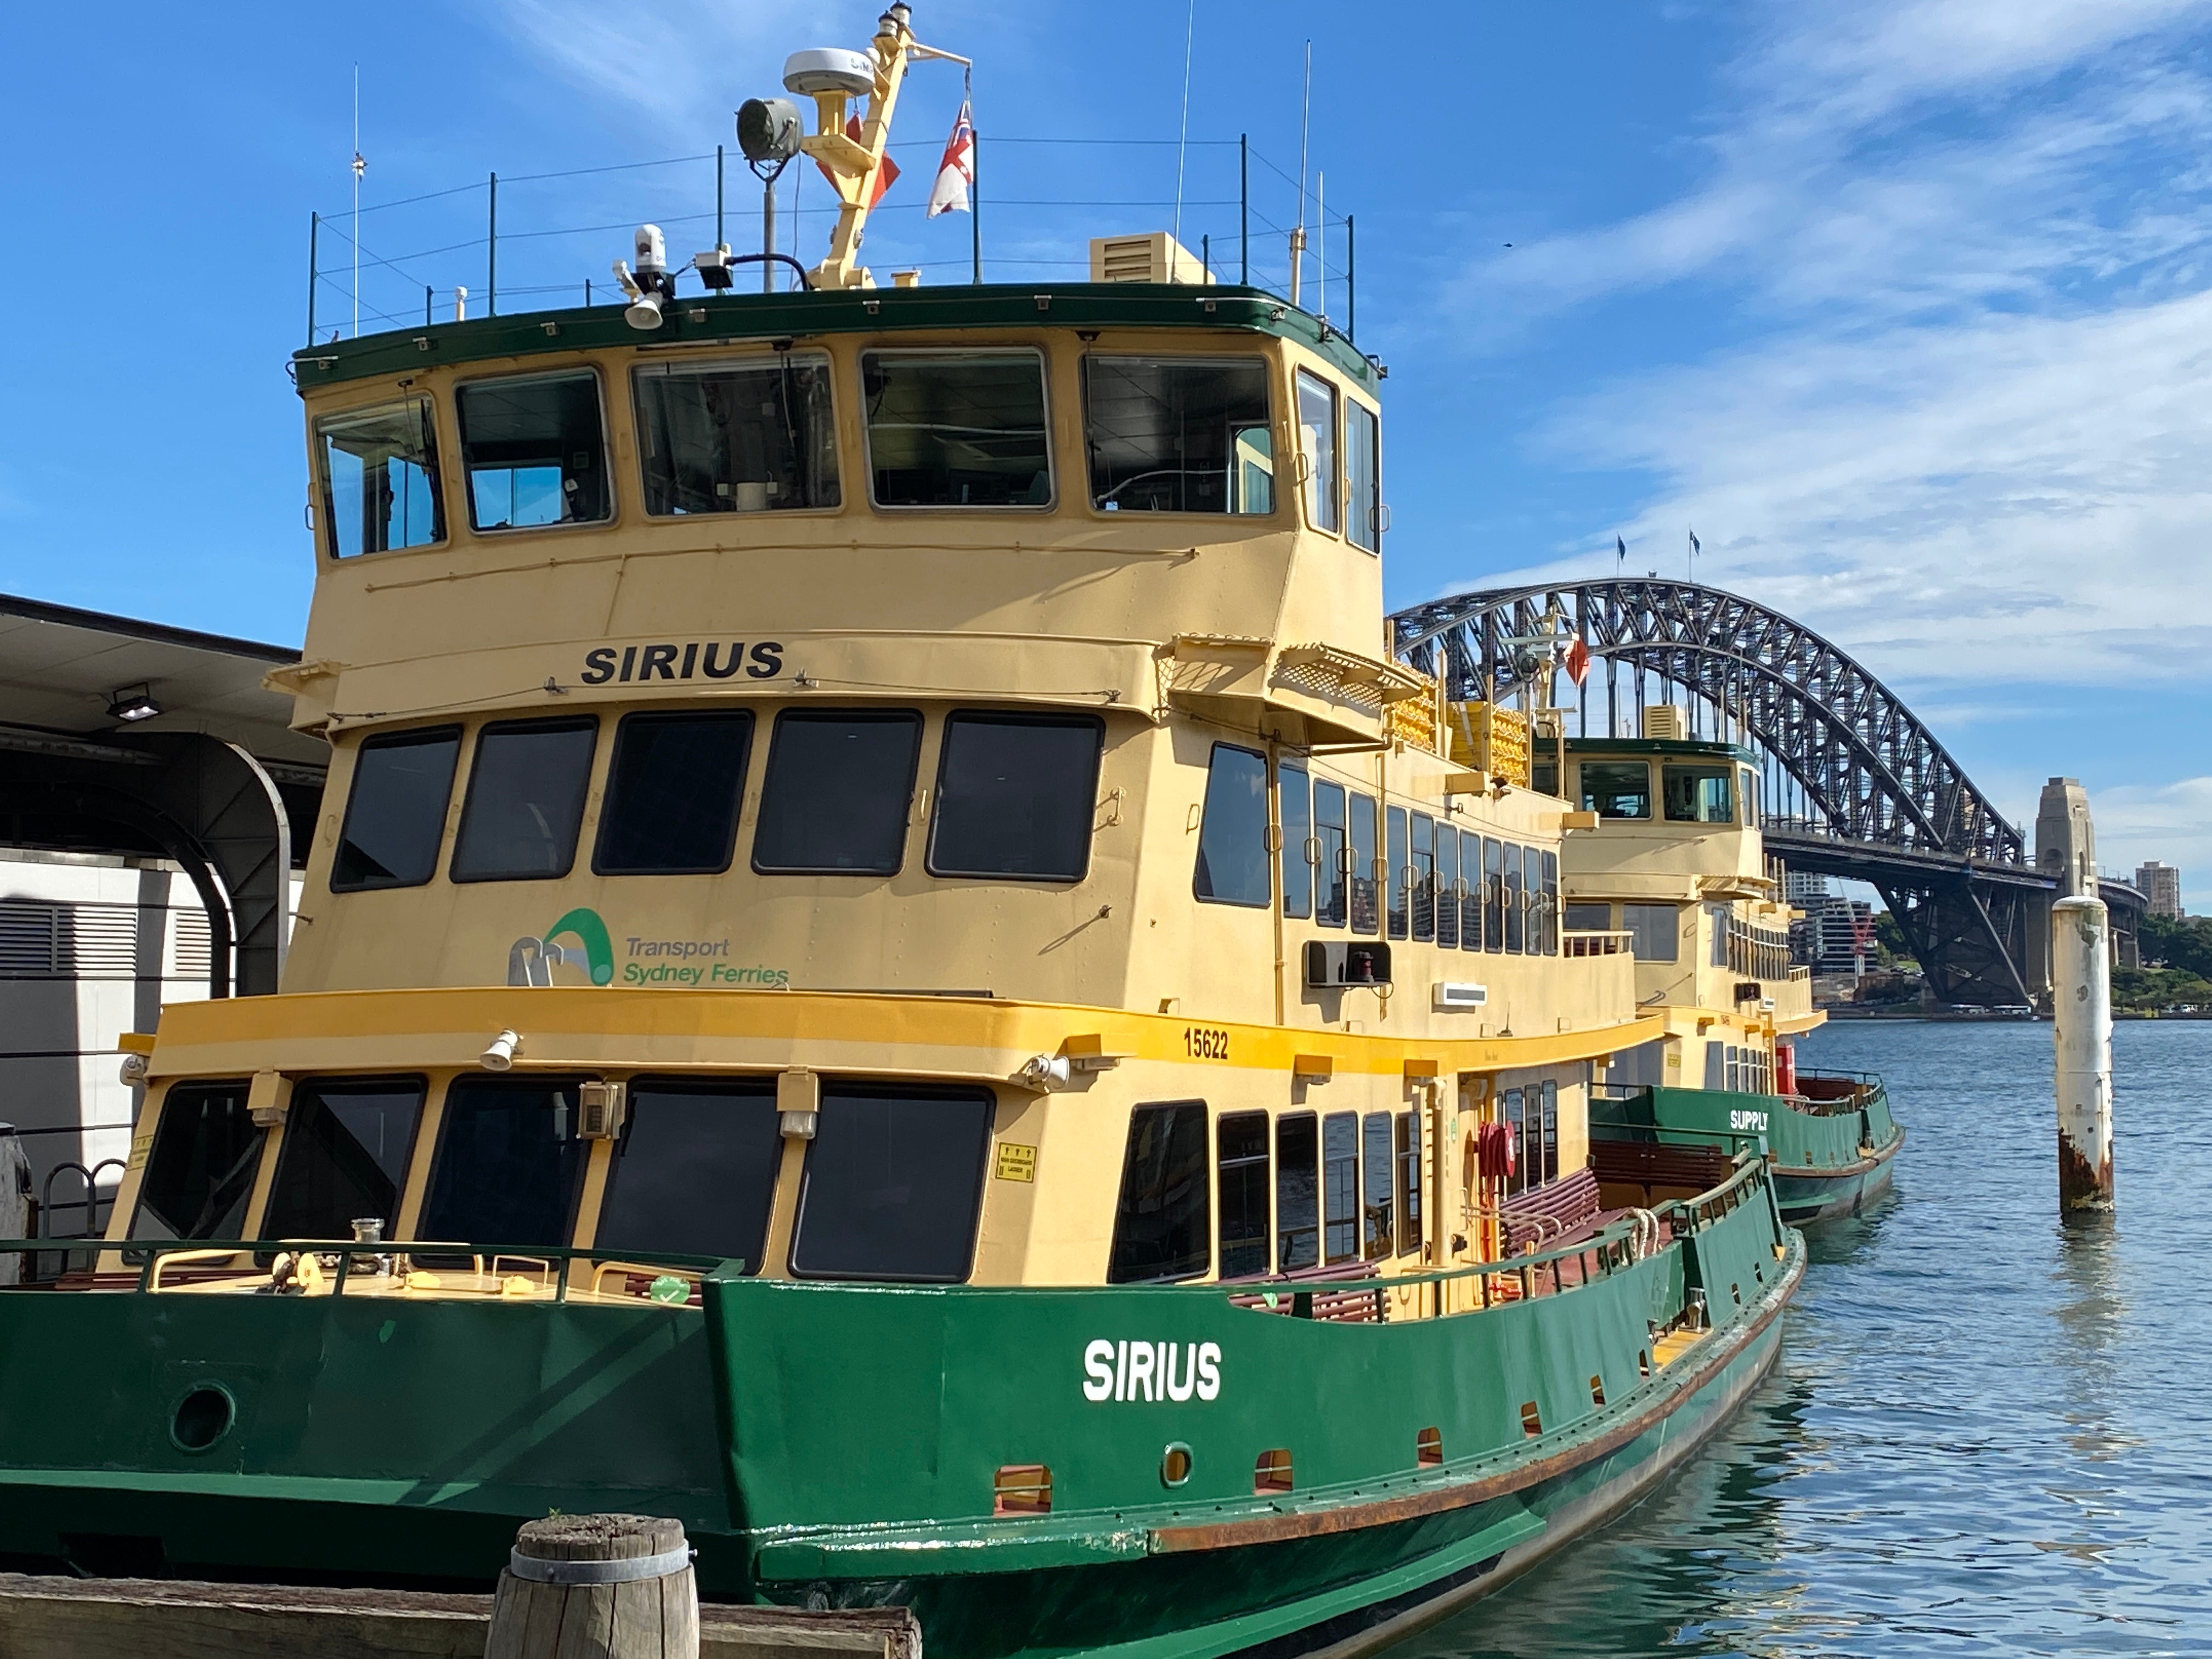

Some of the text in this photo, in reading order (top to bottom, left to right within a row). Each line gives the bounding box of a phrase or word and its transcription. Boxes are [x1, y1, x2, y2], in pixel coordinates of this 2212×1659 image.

[580, 641, 784, 685] SIRIUS
[626, 937, 730, 960] Transport
[624, 962, 789, 986] Sydney Ferries
[1184, 1027, 1228, 1059] 15622
[1730, 1109, 1769, 1131] SUPPLY
[1082, 1339, 1221, 1402] SIRIUS
